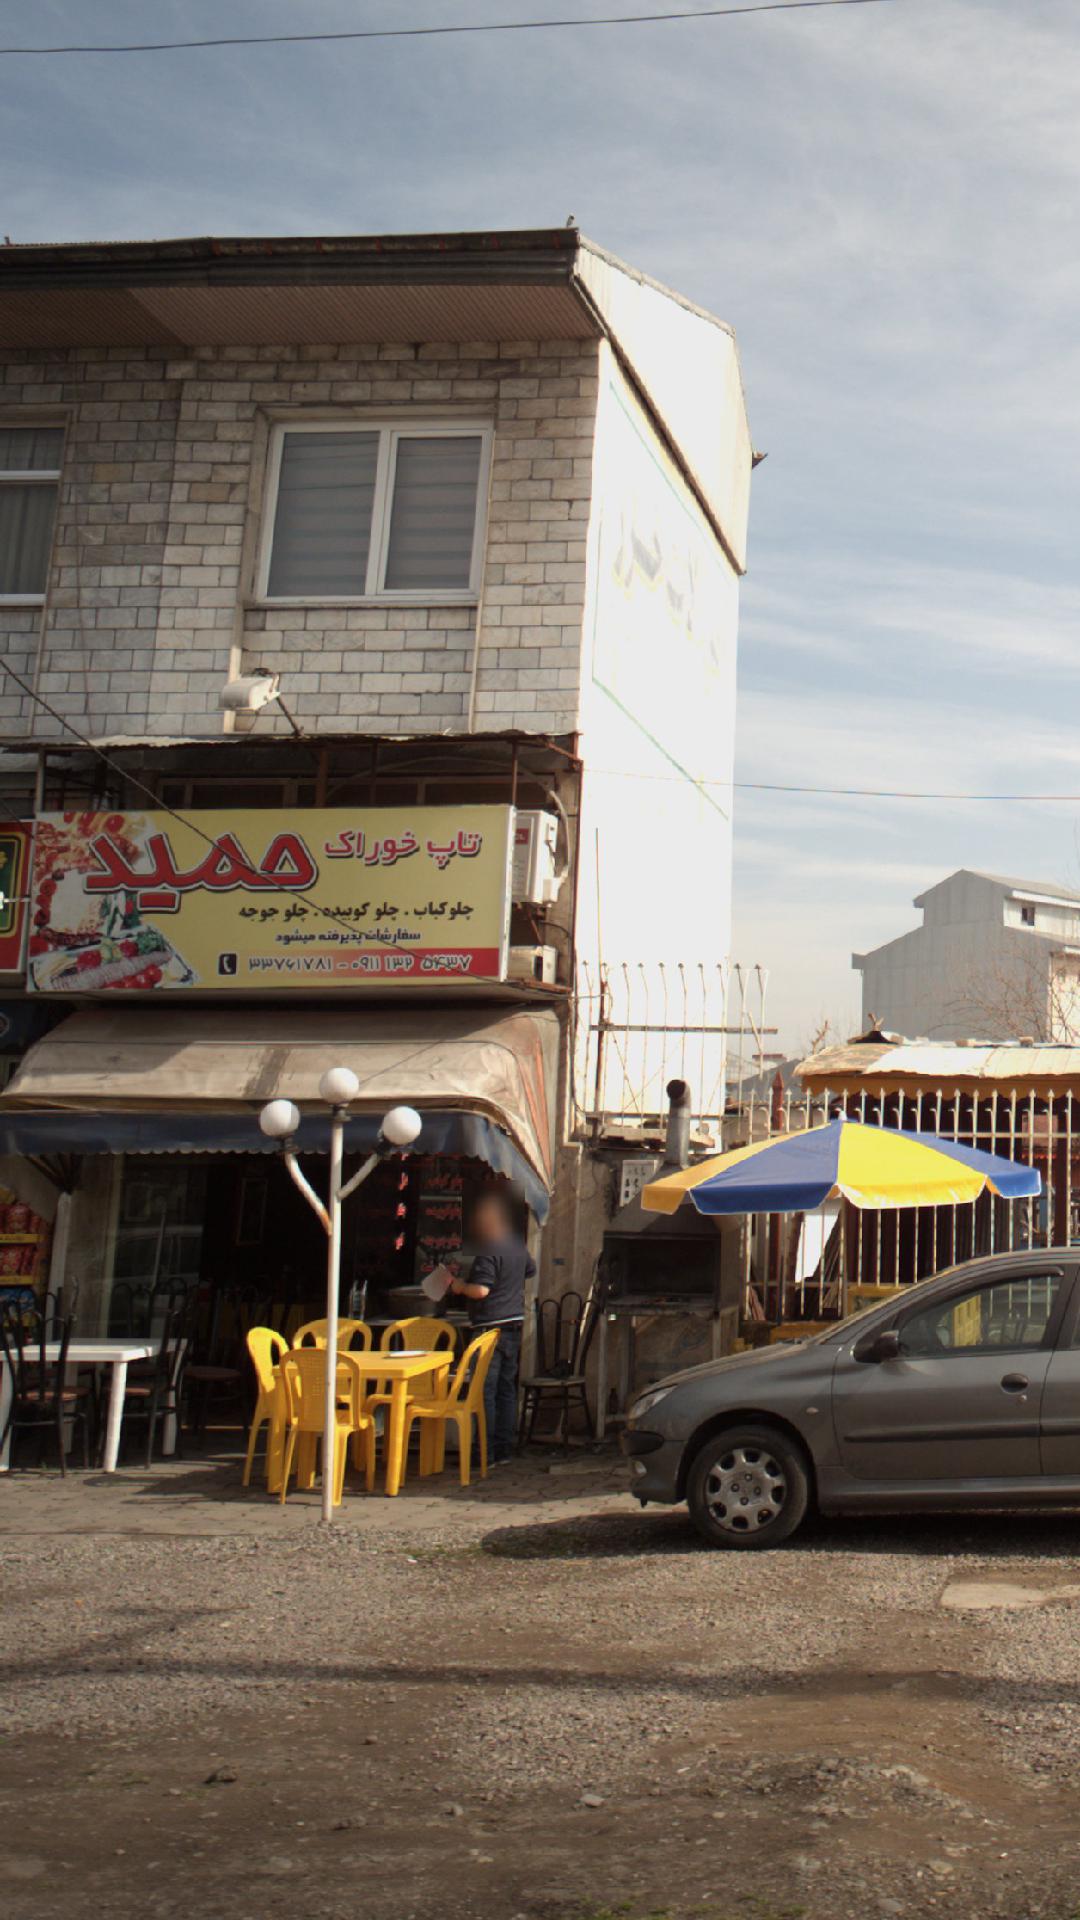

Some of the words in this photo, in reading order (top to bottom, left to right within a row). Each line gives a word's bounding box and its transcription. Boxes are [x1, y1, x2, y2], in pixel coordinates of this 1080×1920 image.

[324, 830, 420, 867] خوراک
[427, 830, 482, 869] تاپ
[84, 832, 318, 913] حمید
[238, 906, 279, 922] جوجه
[322, 901, 371, 921] کوبیده
[365, 927, 421, 944] سفارشات
